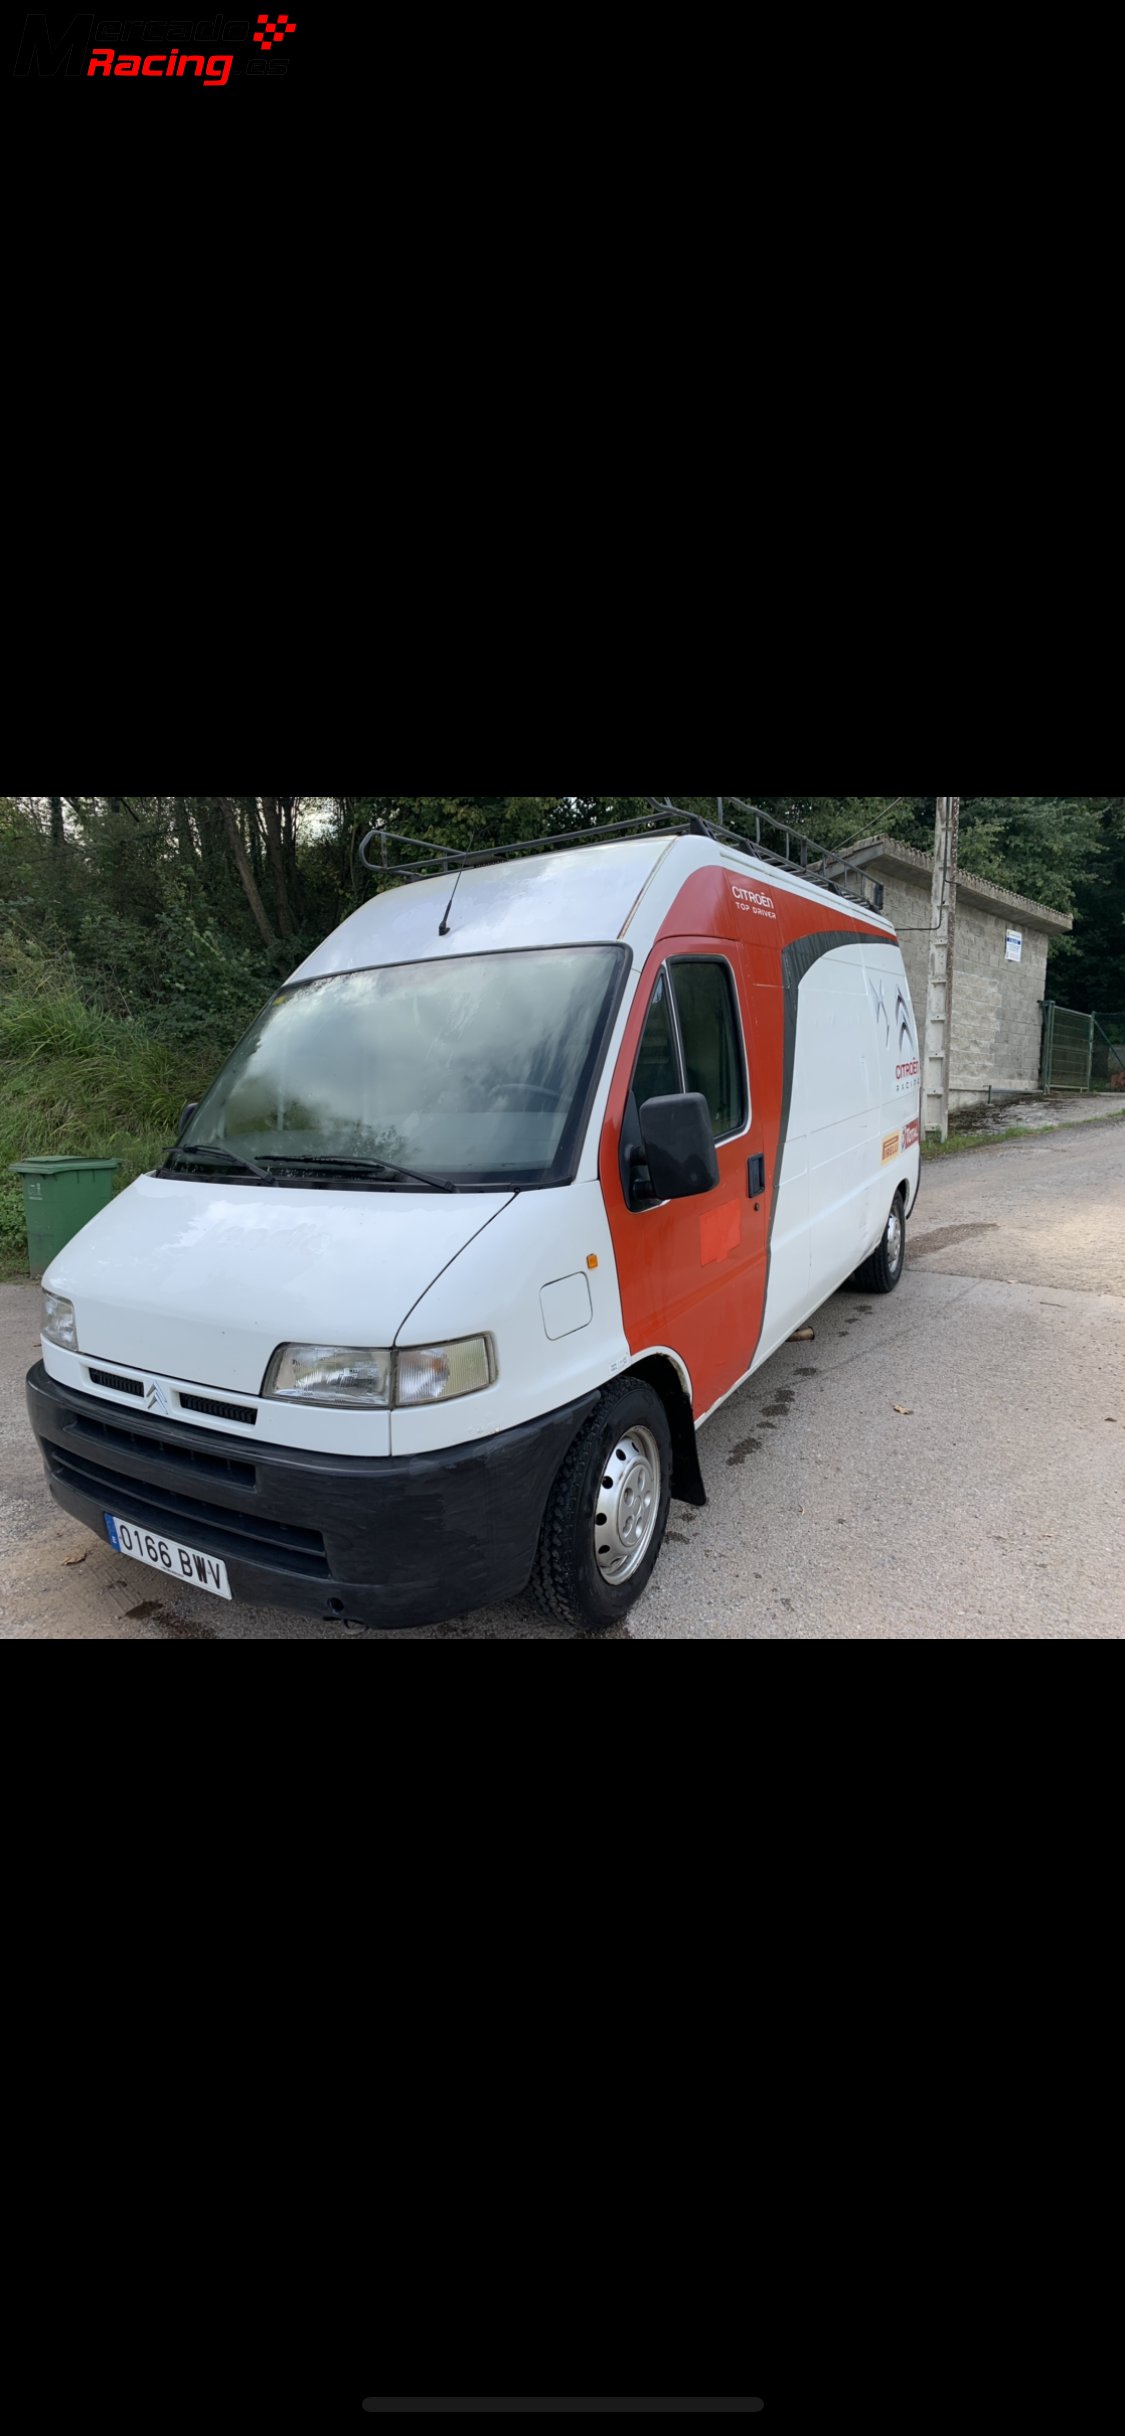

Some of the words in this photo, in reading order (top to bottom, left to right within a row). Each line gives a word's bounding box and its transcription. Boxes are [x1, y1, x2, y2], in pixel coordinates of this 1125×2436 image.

[735, 901, 750, 911] TOP
[752, 906, 776, 919] DRIVER
[120, 1525, 172, 1568] 0166
[178, 1548, 220, 1589] BWV
